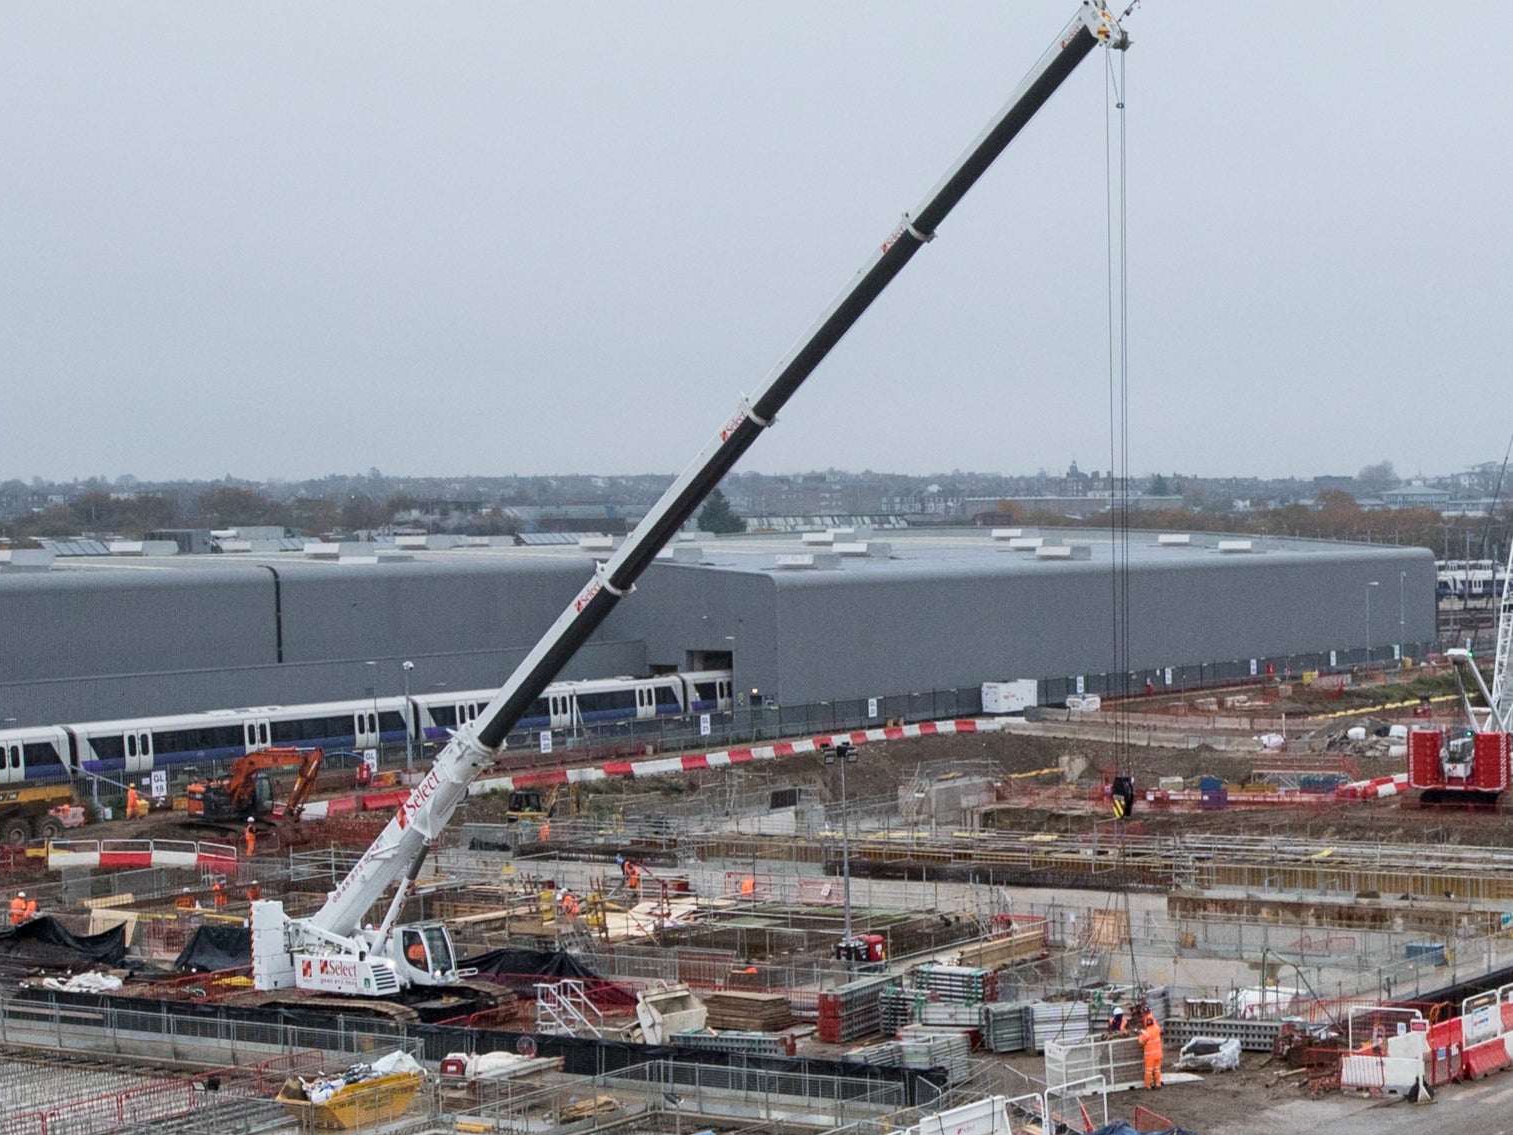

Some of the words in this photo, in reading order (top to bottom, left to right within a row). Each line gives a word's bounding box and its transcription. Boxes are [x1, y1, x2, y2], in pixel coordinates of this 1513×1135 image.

[366, 752, 375, 761] GL
[153, 774, 165, 783] GL
[405, 771, 440, 817] Select
[329, 960, 357, 977] Select
